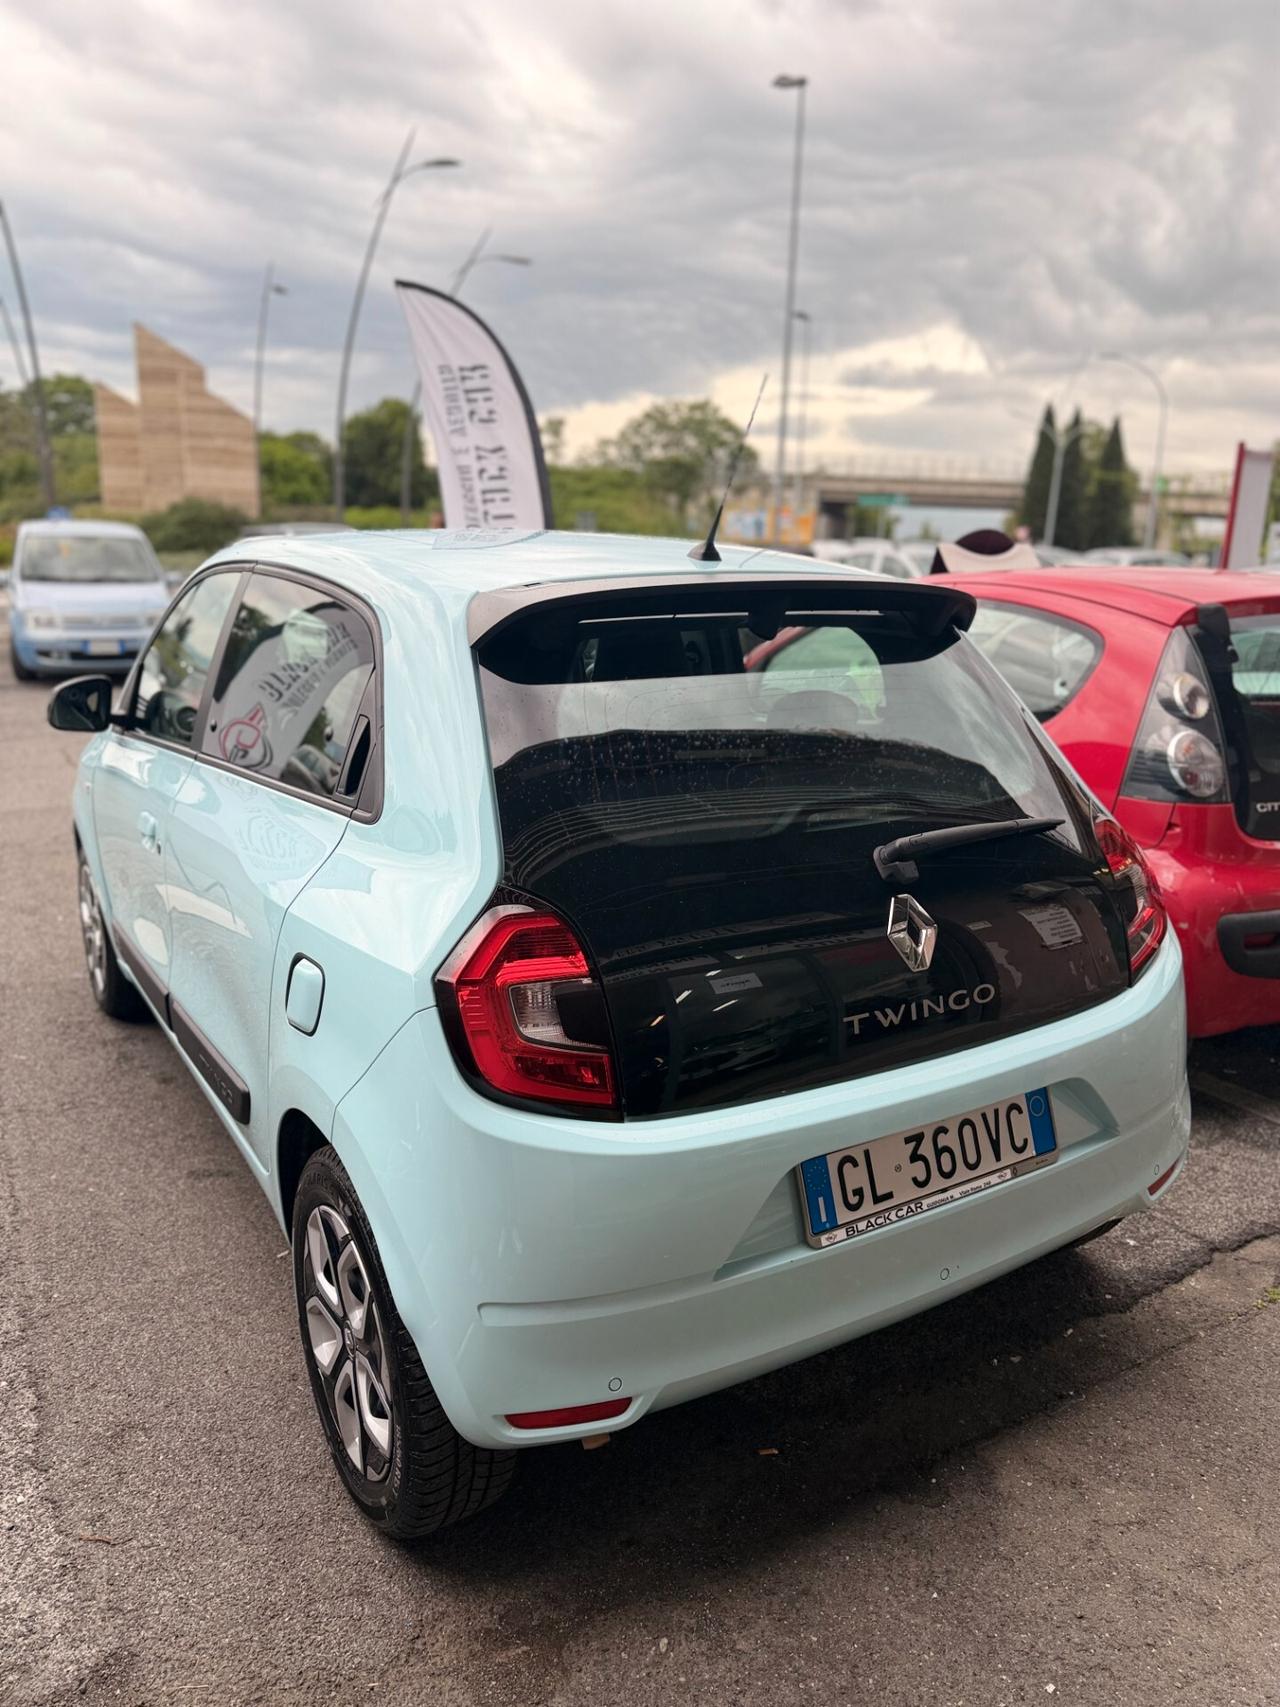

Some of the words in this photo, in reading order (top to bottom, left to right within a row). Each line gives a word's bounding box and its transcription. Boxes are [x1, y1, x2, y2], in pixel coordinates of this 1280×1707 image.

[842, 983, 995, 1035] TWINGO
[837, 1149, 894, 1212] GL
[904, 1103, 1028, 1188] 360VC
[845, 1212, 893, 1238] BLACK
[895, 1201, 924, 1219] CAR
